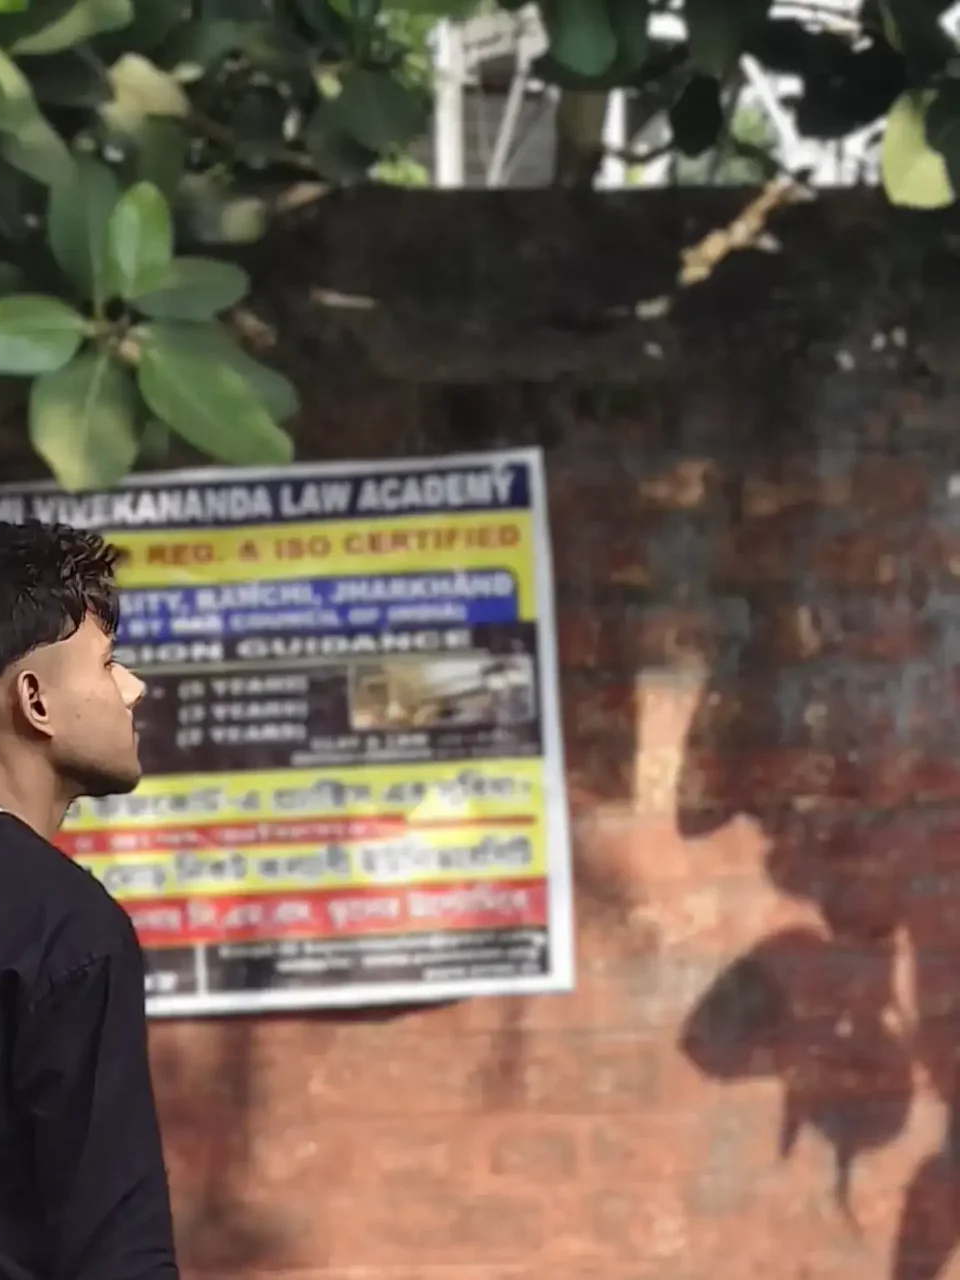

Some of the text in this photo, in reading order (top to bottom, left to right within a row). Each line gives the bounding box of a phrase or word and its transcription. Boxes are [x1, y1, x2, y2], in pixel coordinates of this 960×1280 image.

[278, 480, 353, 517] LAW
[356, 465, 516, 511] ACADEMY
[343, 523, 521, 556] CERTIFIED
